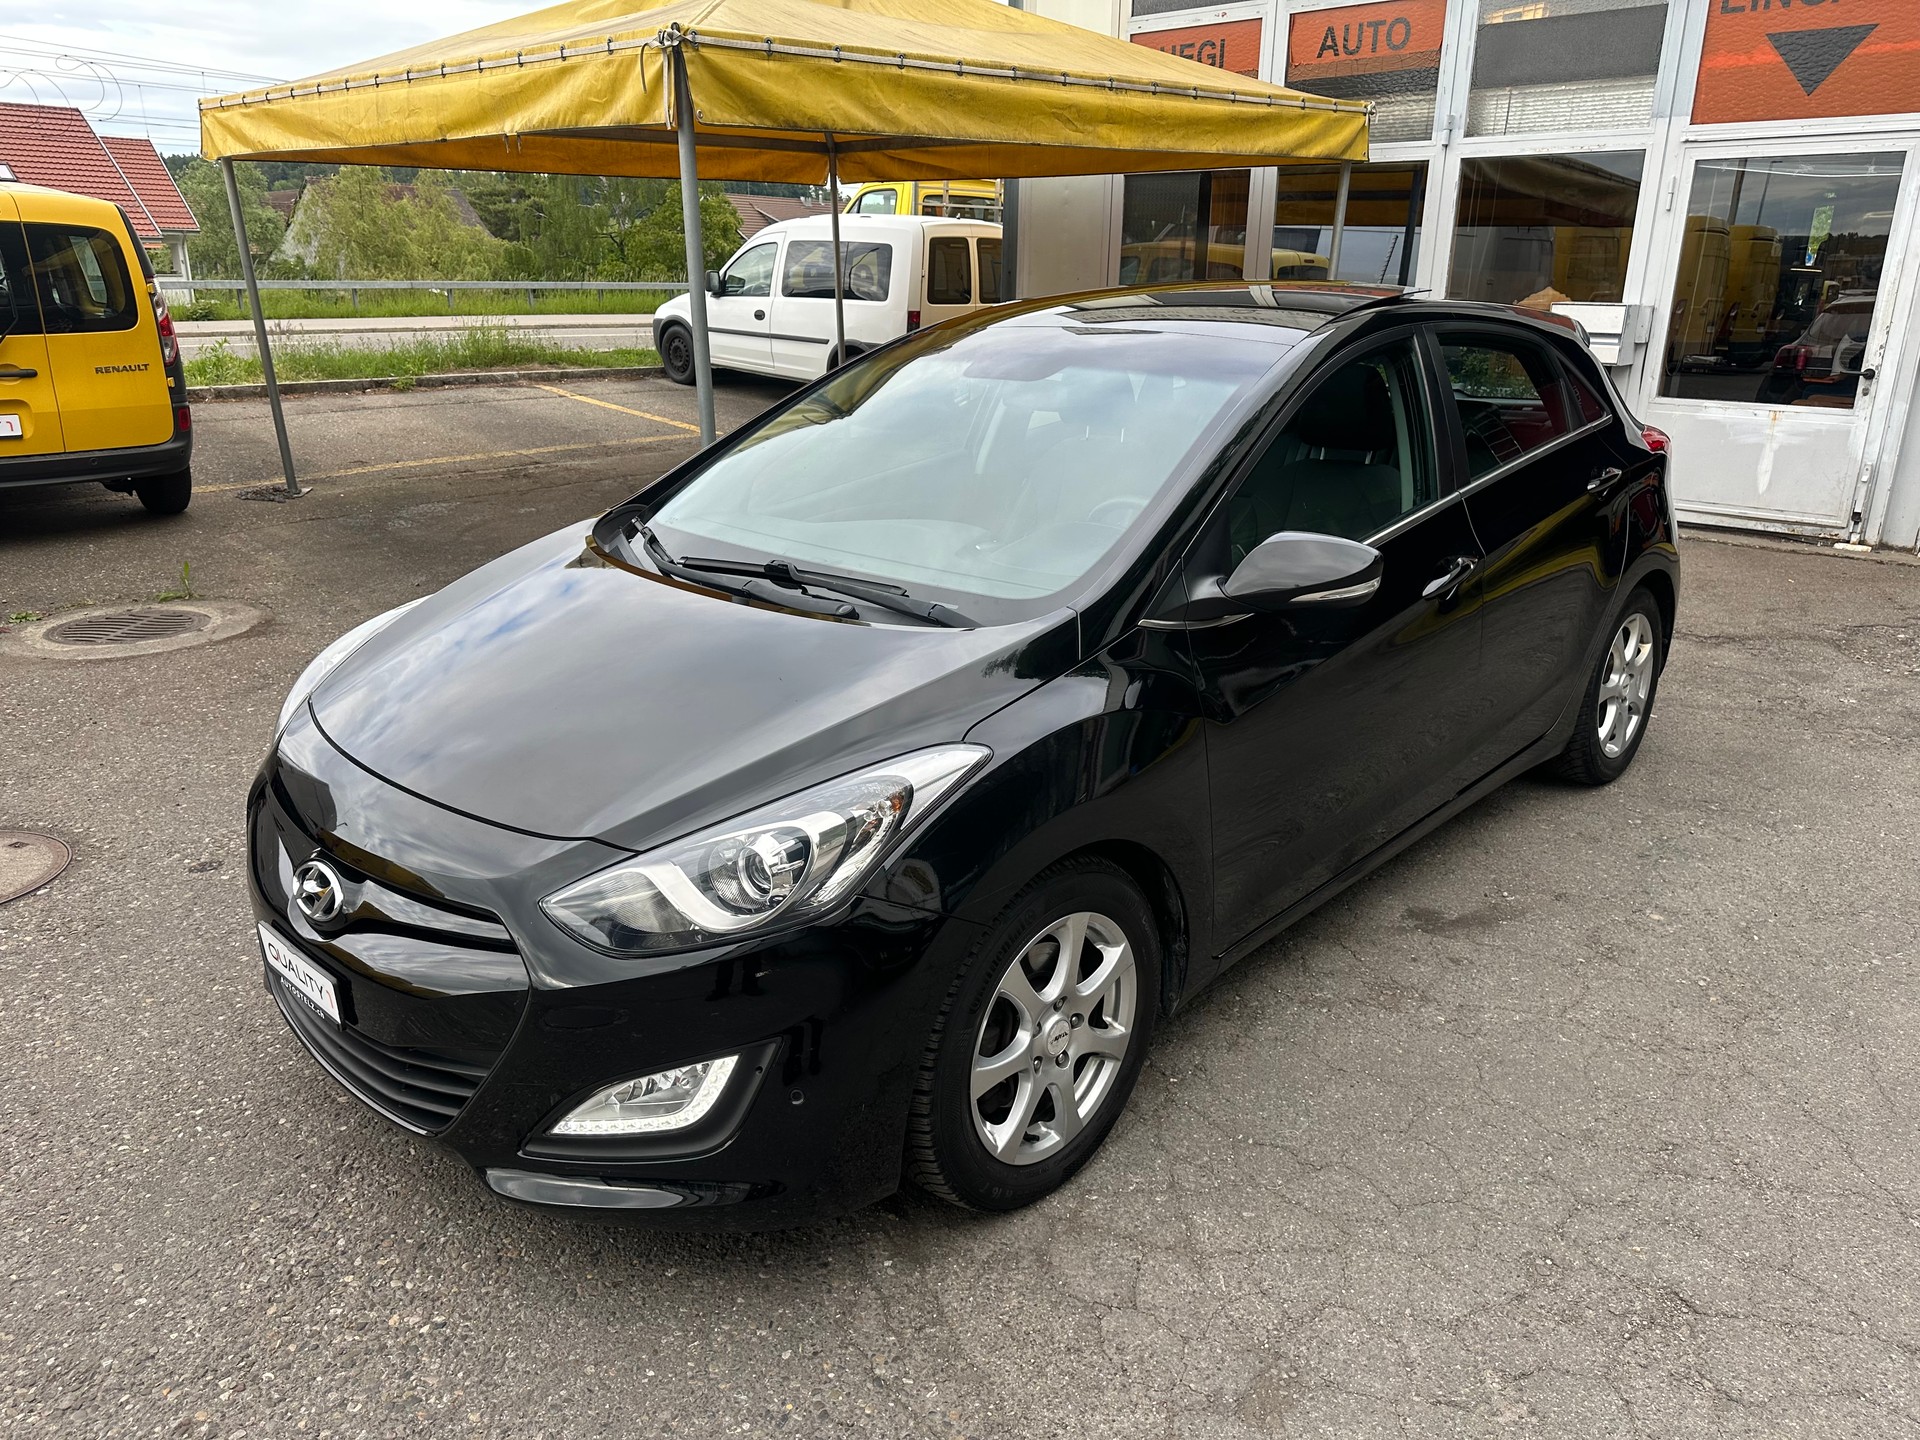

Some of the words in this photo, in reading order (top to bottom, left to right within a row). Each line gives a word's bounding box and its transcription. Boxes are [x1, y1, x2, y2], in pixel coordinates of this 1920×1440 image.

[1316, 16, 1412, 58] AUTO
[95, 363, 150, 374] RENAULT
[268, 942, 325, 1000] QUALITY
